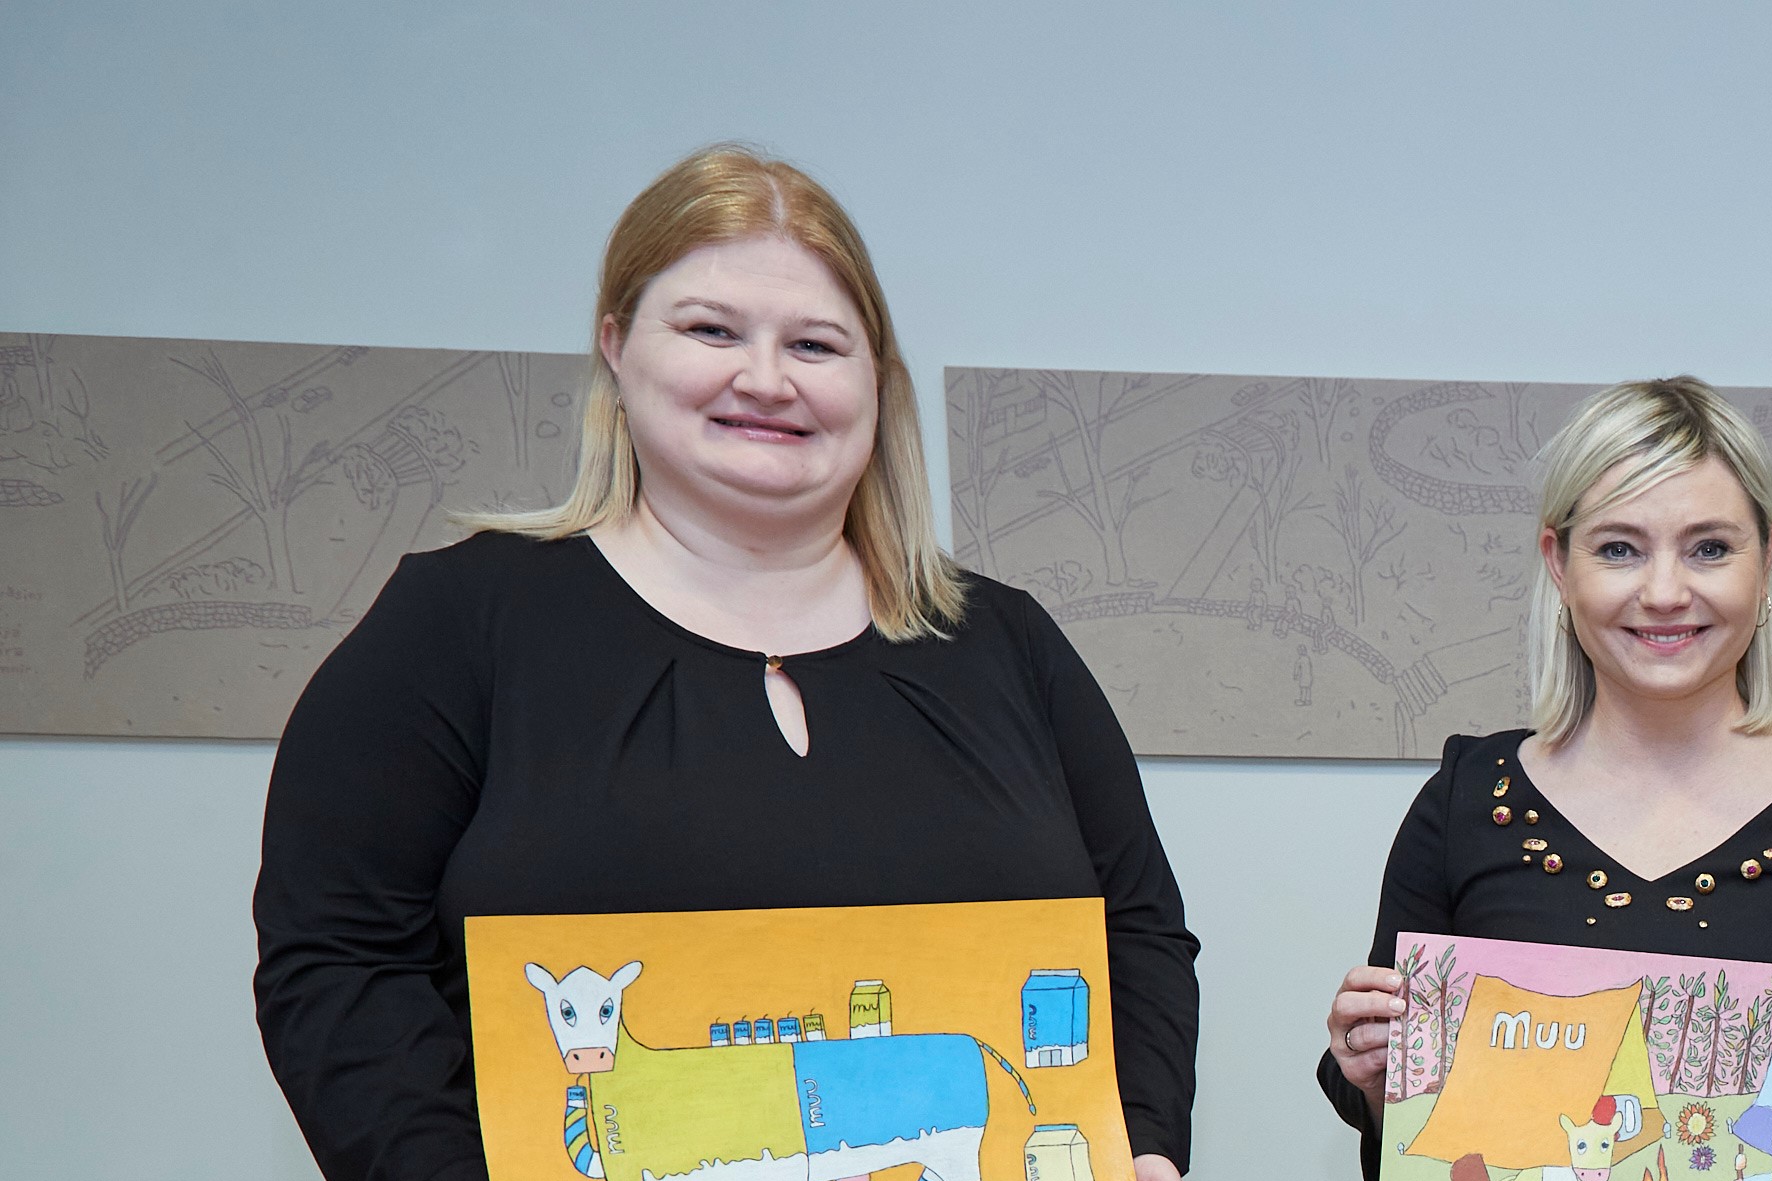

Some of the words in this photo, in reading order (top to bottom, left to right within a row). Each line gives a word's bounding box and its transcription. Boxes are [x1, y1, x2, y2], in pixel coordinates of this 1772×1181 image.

[852, 1001, 880, 1014] muu
[803, 1077, 826, 1129] muu
[603, 1103, 625, 1156] muu
